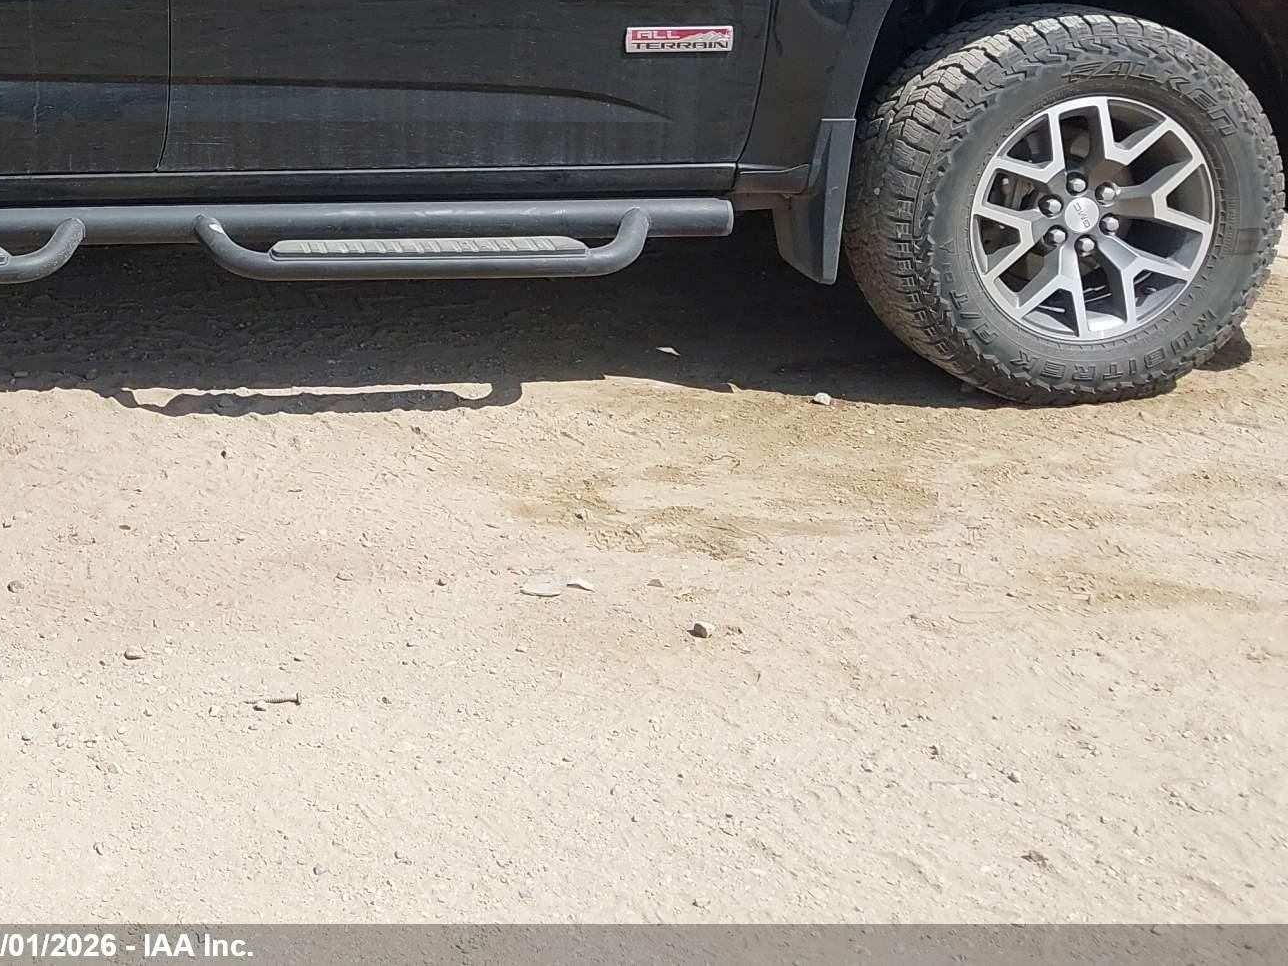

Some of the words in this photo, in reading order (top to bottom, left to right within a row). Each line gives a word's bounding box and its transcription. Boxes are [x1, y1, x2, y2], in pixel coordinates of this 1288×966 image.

[631, 41, 729, 50] TERRAIN
[636, 30, 681, 39] ALL
[1073, 201, 1091, 228] GMC
[949, 288, 999, 345] A/T
[1010, 307, 1217, 382] RUBITREK
